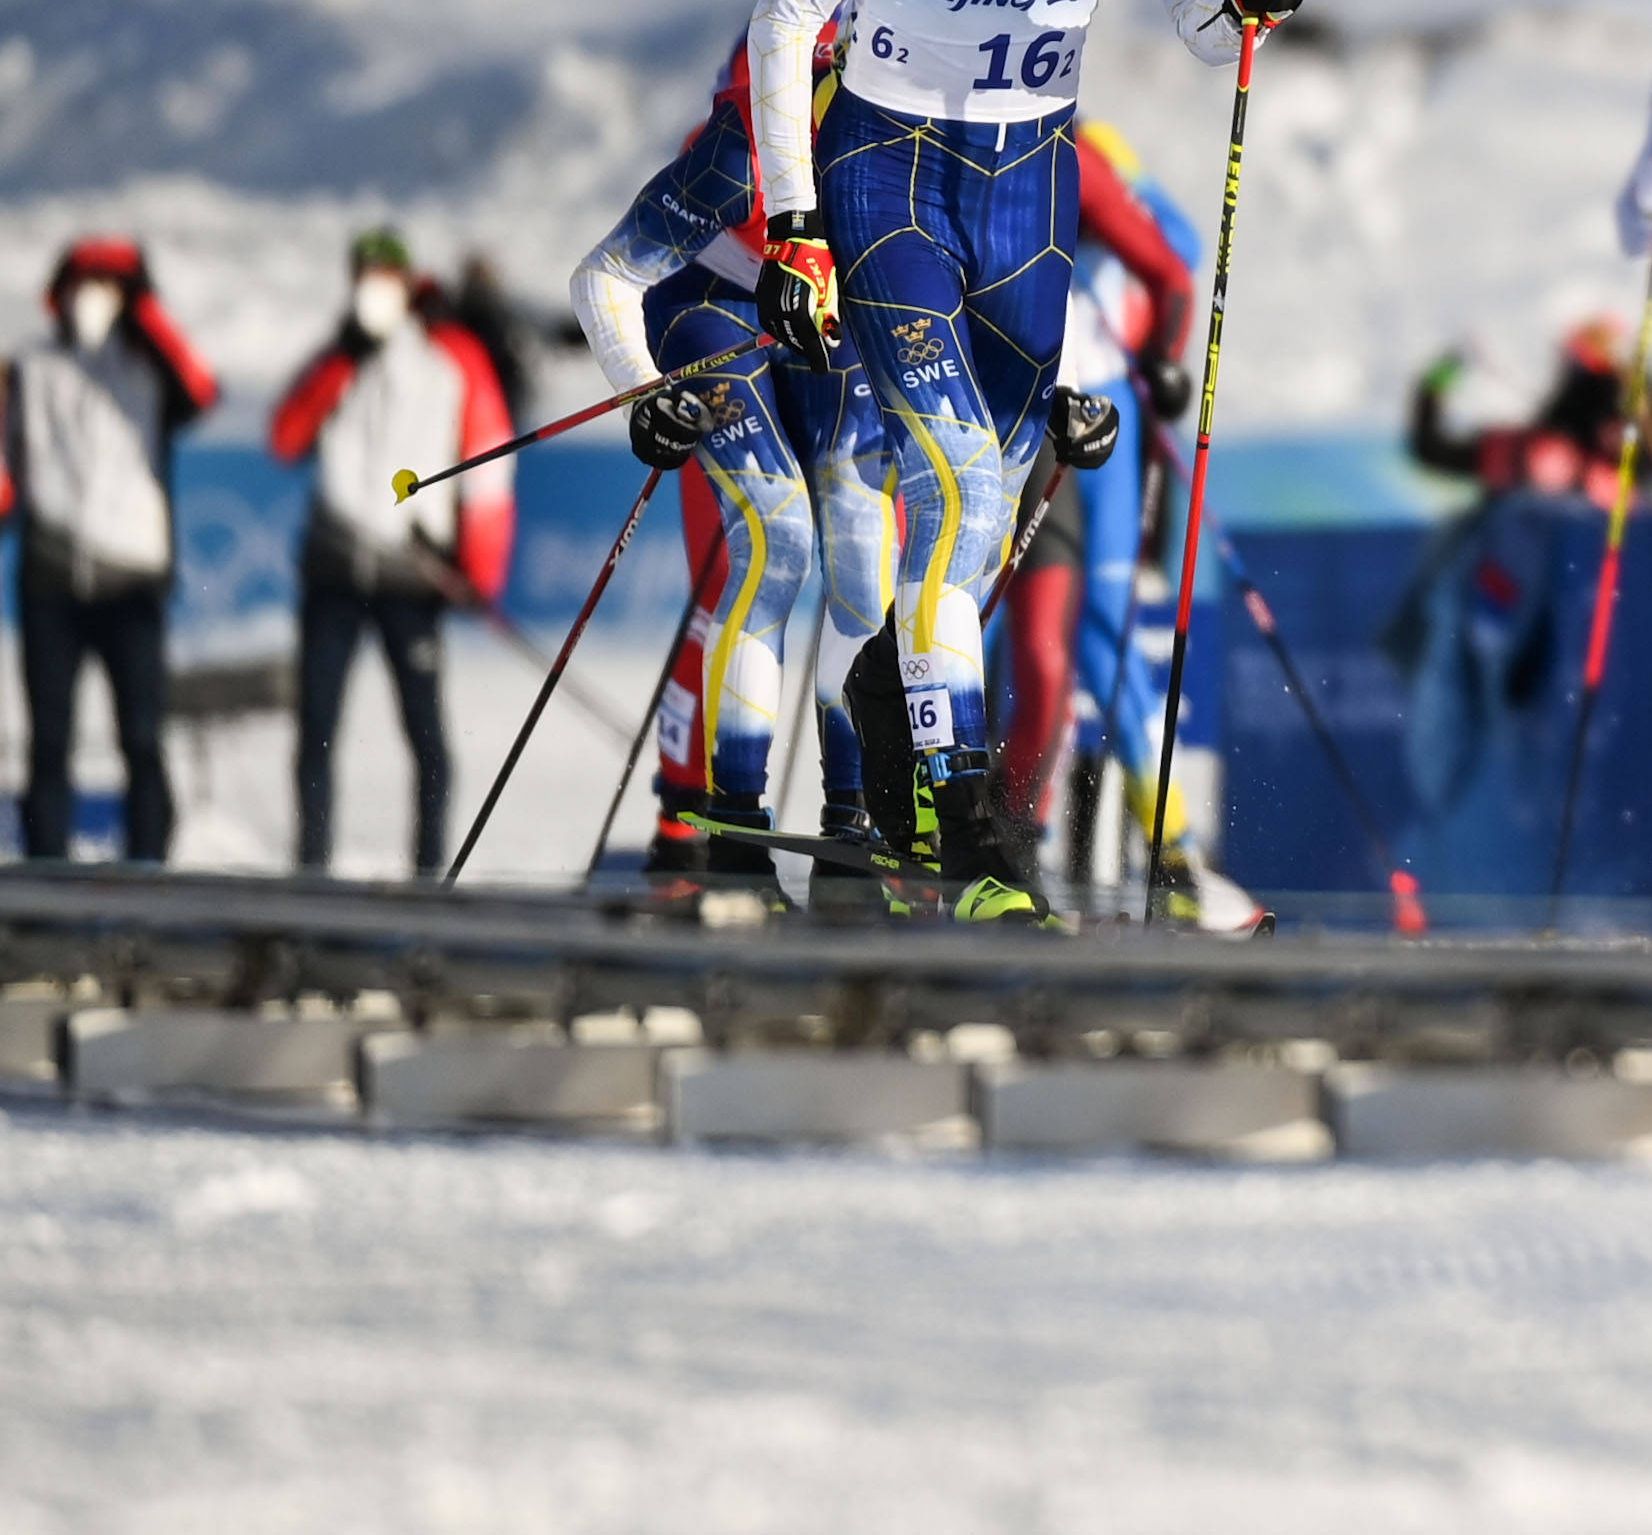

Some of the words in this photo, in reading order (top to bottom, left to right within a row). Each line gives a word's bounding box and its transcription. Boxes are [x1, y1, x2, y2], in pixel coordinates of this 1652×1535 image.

[1224, 142, 1243, 207] LEKI
[902, 358, 960, 390] SWE
[711, 415, 763, 449] SWE
[909, 699, 937, 730] 16
[870, 853, 900, 870] FISCHER
